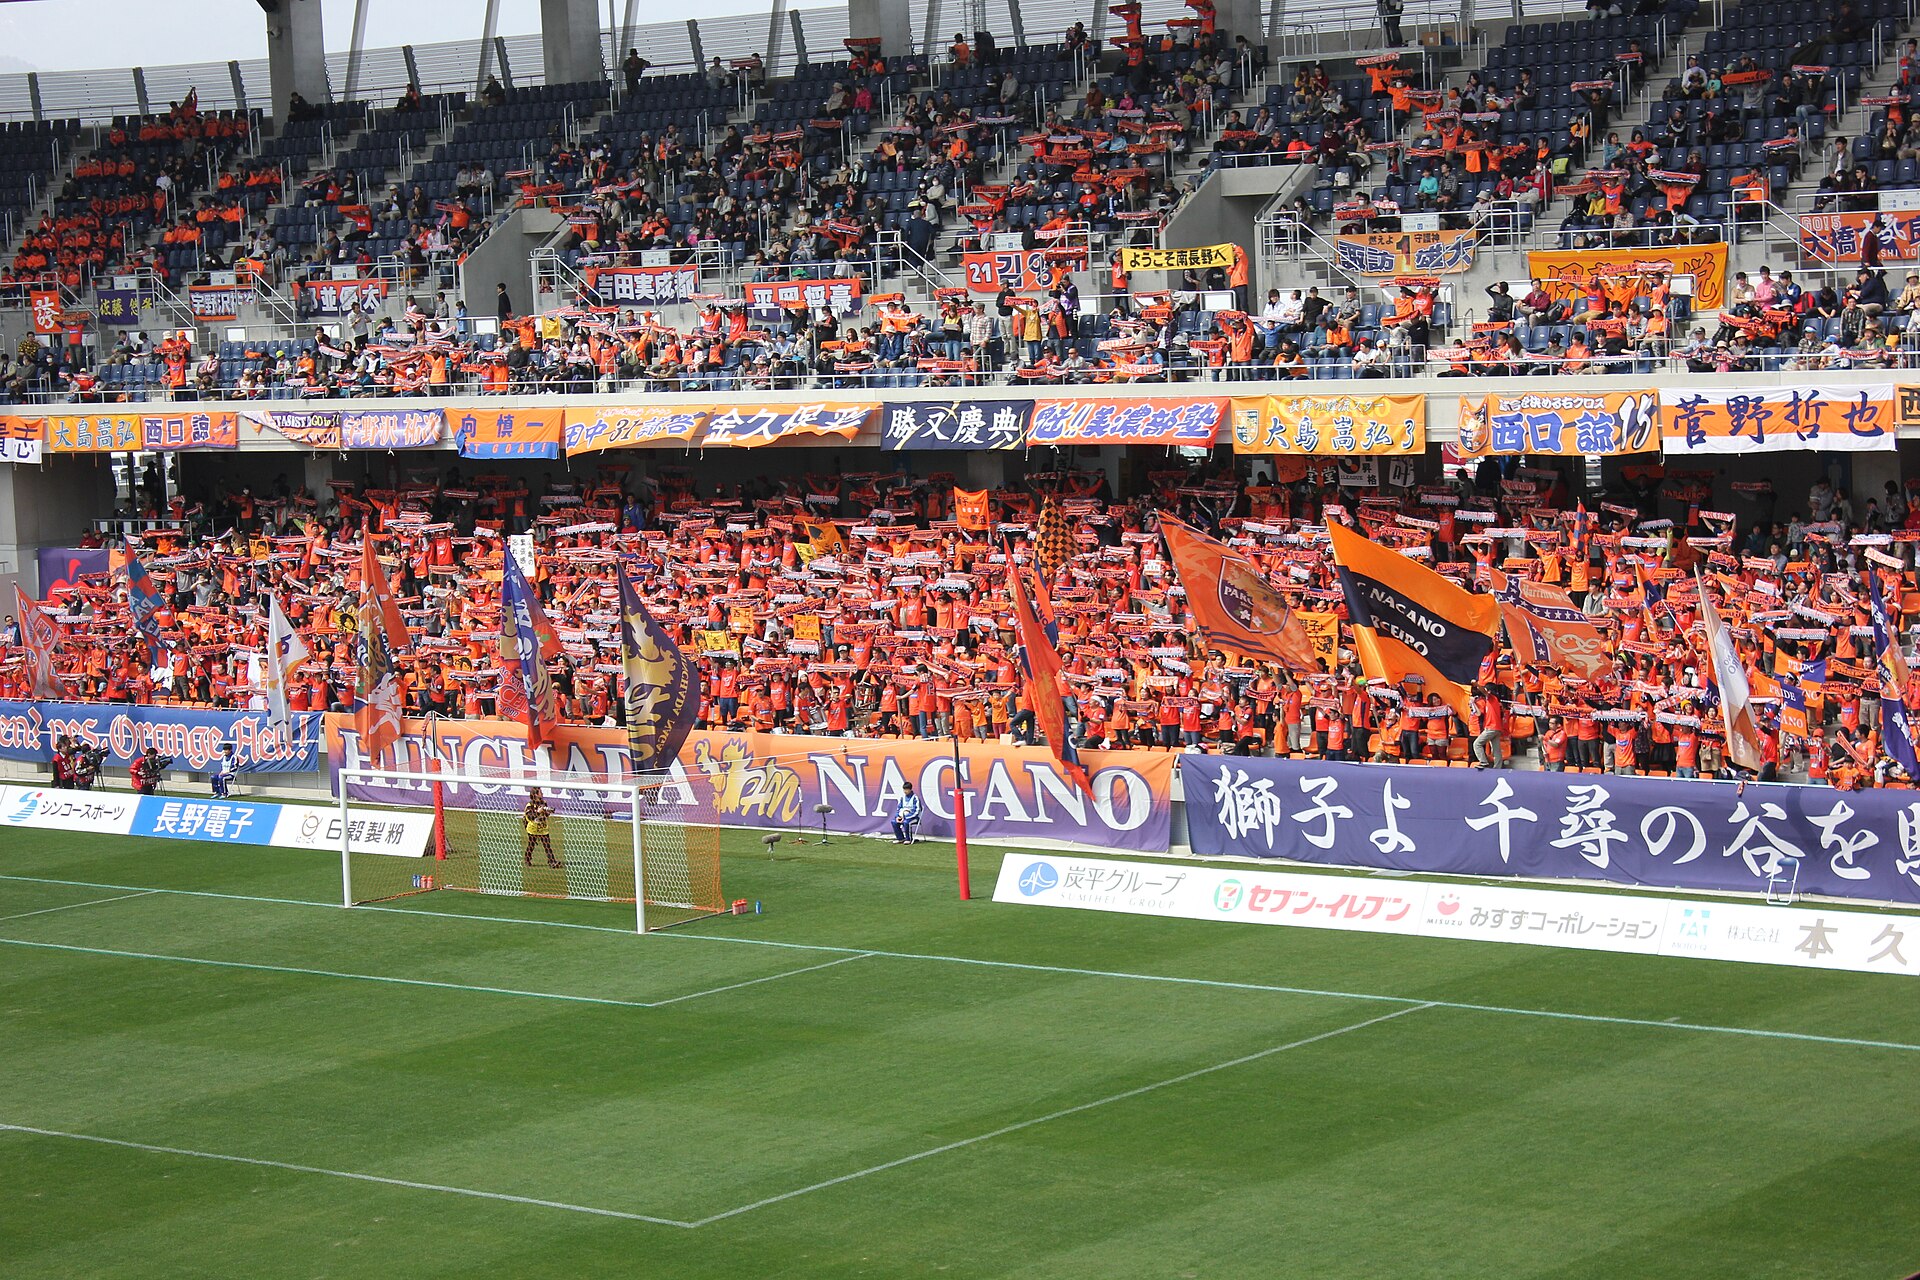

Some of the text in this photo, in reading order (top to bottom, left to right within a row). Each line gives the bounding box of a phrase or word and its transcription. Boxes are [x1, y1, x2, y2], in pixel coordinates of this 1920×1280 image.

[968, 262, 992, 284] 21
[1130, 249, 1227, 268] ようこそ南長野へ
[884, 405, 1019, 444] 勝又慶典
[1673, 389, 1885, 450] 菅野哲也
[492, 442, 548, 454] GOAL!
[808, 752, 1153, 832] NAGANO
[40, 800, 126, 822] シンコースポーツ
[153, 801, 256, 839] 長野電子
[1063, 865, 1187, 896] 炭平グループ
[1426, 917, 1464, 926] MISUZU
[1469, 906, 1658, 940] みすずコーポレーション
